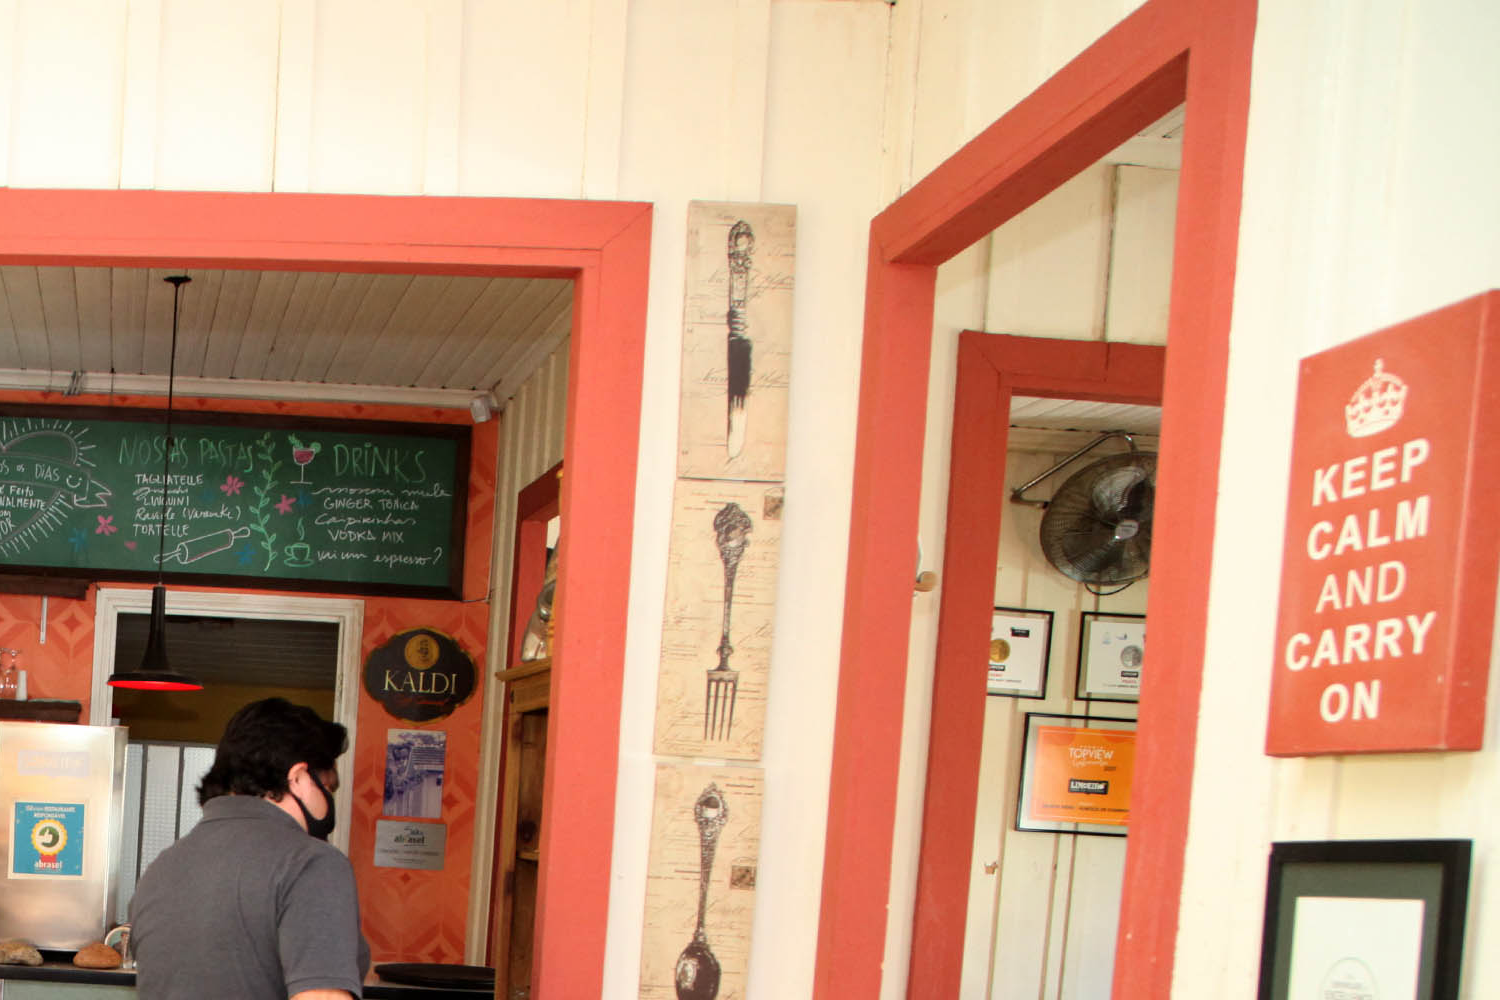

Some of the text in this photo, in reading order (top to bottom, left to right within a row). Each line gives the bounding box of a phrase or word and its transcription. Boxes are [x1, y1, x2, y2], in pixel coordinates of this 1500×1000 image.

[34, 463, 61, 481] DIAS
[199, 438, 253, 473] PASTAS
[333, 442, 426, 483] DRINKS
[1311, 438, 1429, 506] KEEP
[323, 496, 373, 511] GINGER
[132, 523, 190, 538] TORTELLE
[327, 529, 404, 544] VODKA MIX
[1307, 495, 1430, 560] CALM
[1314, 560, 1406, 614] AND
[1285, 610, 1436, 671] CARRY
[383, 669, 457, 695] KALDI
[1320, 679, 1381, 722] ON
